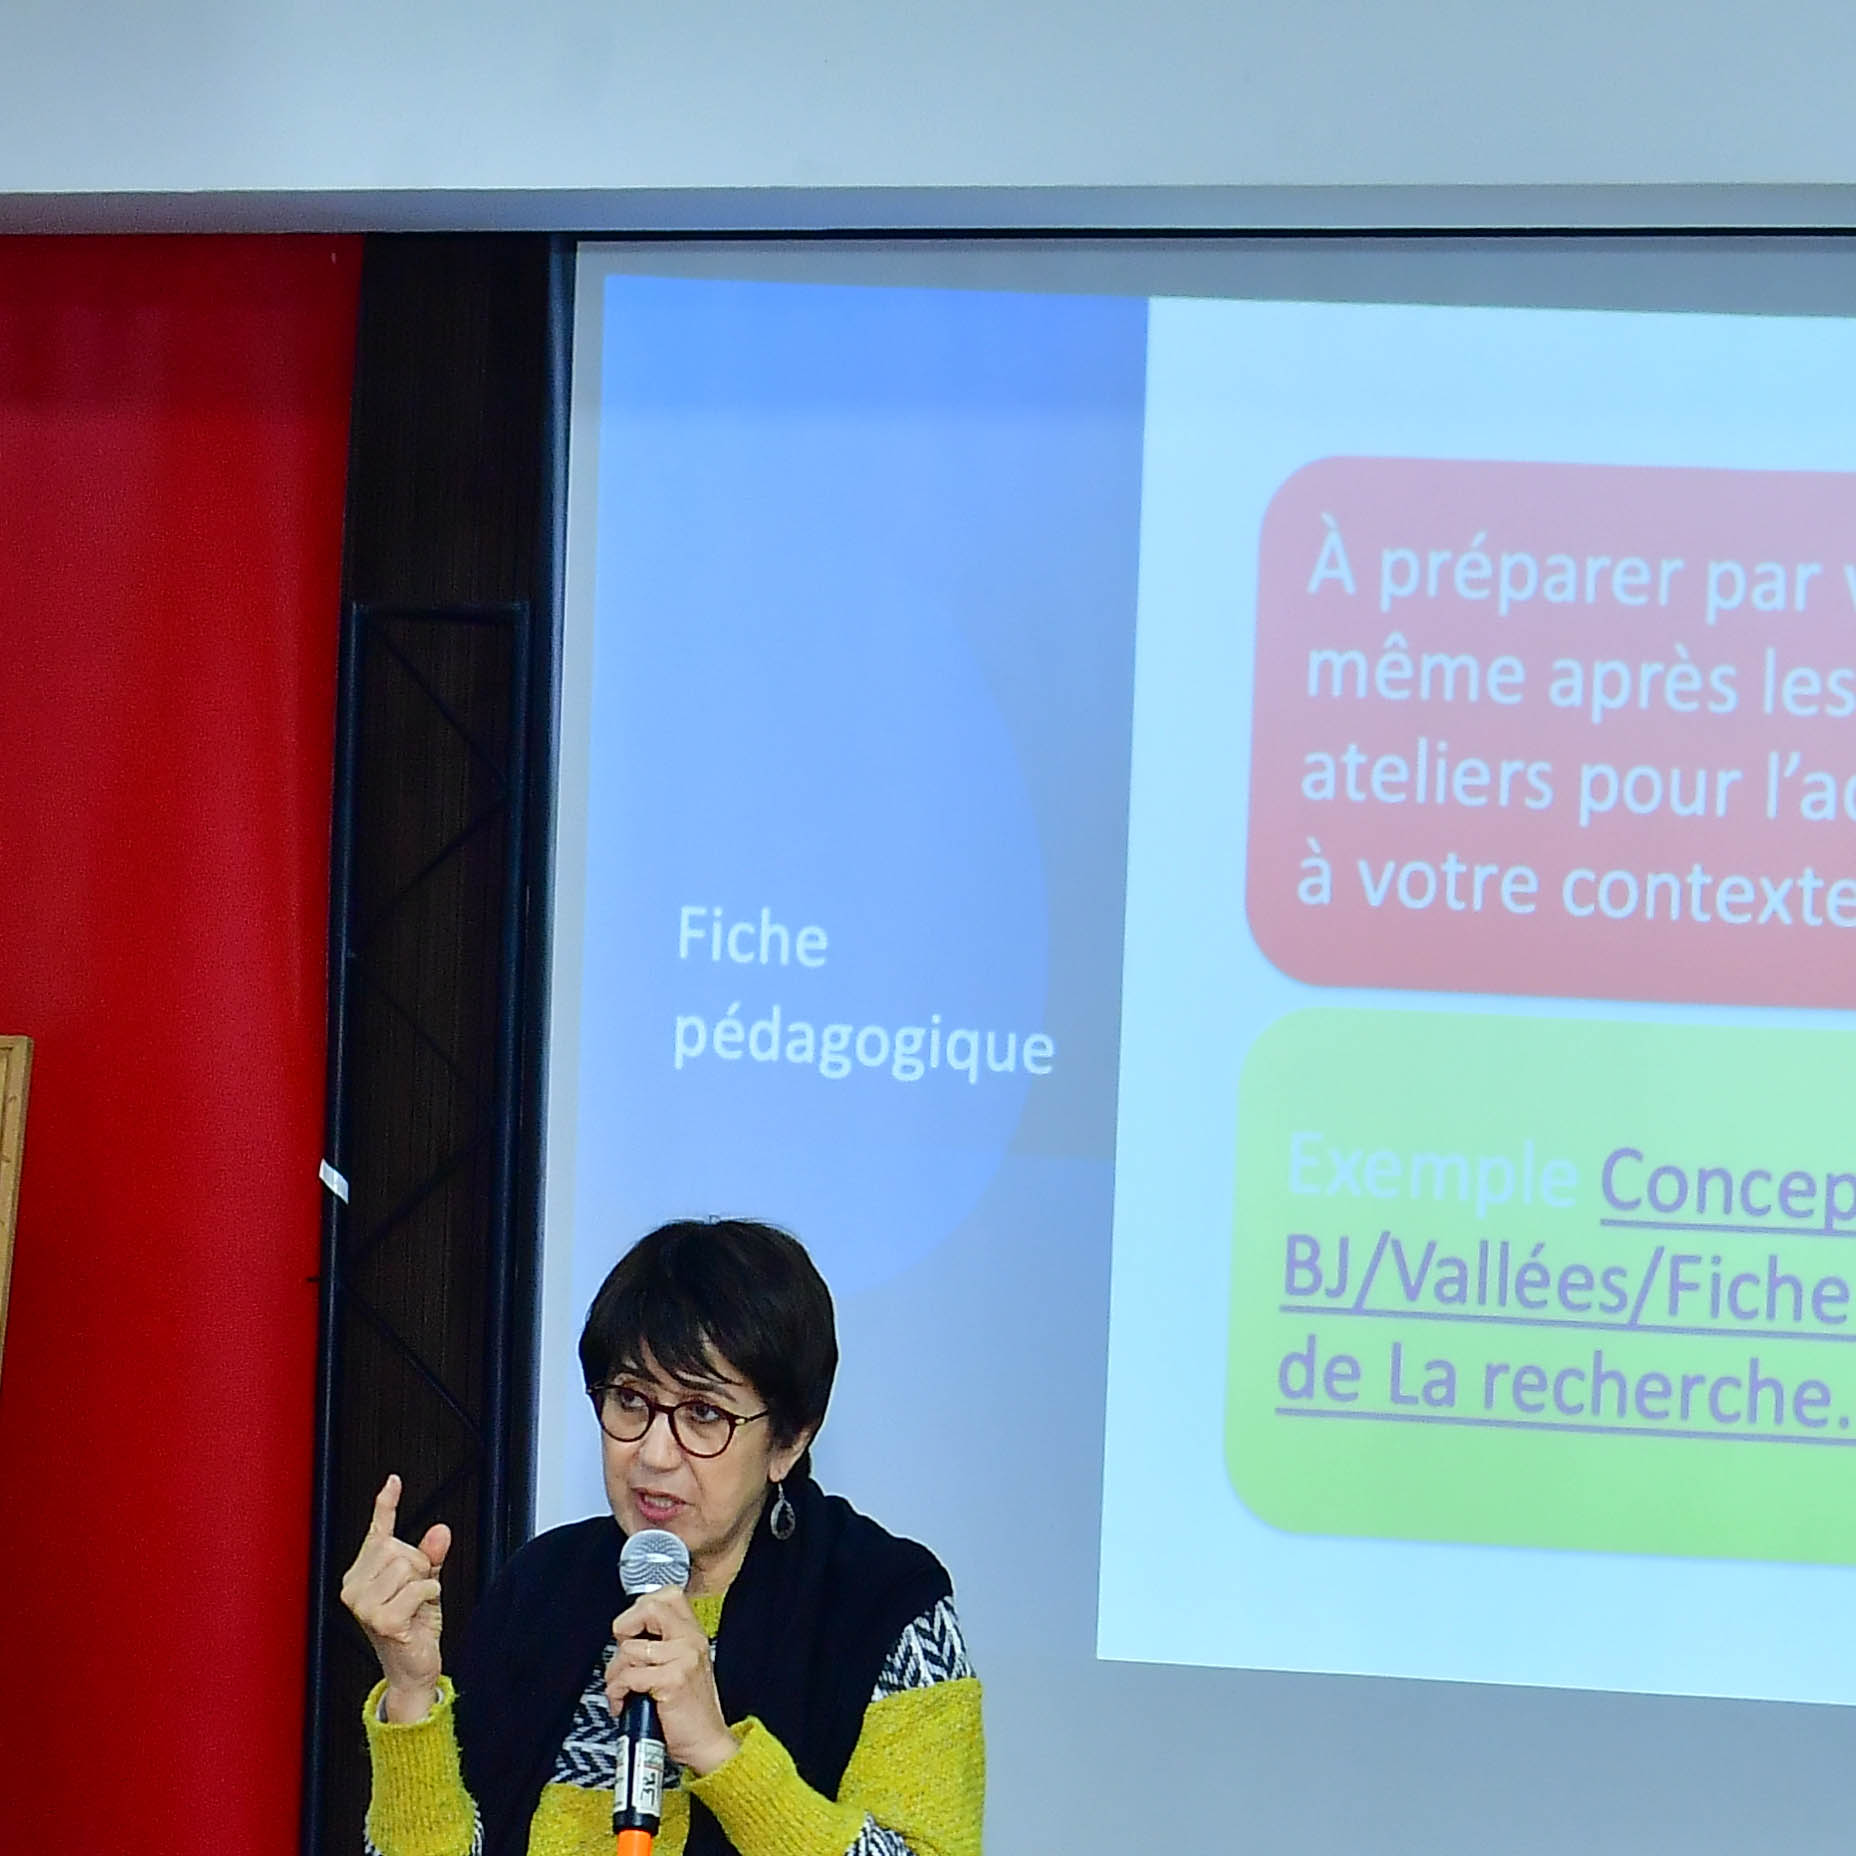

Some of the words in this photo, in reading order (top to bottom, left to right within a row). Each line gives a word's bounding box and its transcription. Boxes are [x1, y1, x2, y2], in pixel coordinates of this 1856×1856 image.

[1308, 514, 1356, 595] À
[1378, 533, 1683, 614] préparer
[1705, 555, 1822, 623] par
[1308, 636, 1525, 706] même
[1549, 646, 1738, 722] après
[1762, 650, 1856, 717] les
[1300, 739, 1553, 811] ateliers
[1578, 764, 1742, 827] pour
[1297, 841, 1333, 906] à
[1358, 854, 1538, 916] votre
[678, 905, 829, 967] Fiche
[673, 1001, 1056, 1085] pédagogique
[1286, 1133, 1580, 1219] Exemple
[1282, 1232, 1852, 1328] BJ/Vallées/Fiche
[1277, 1336, 1364, 1403] de
[1388, 1341, 1459, 1409] La
